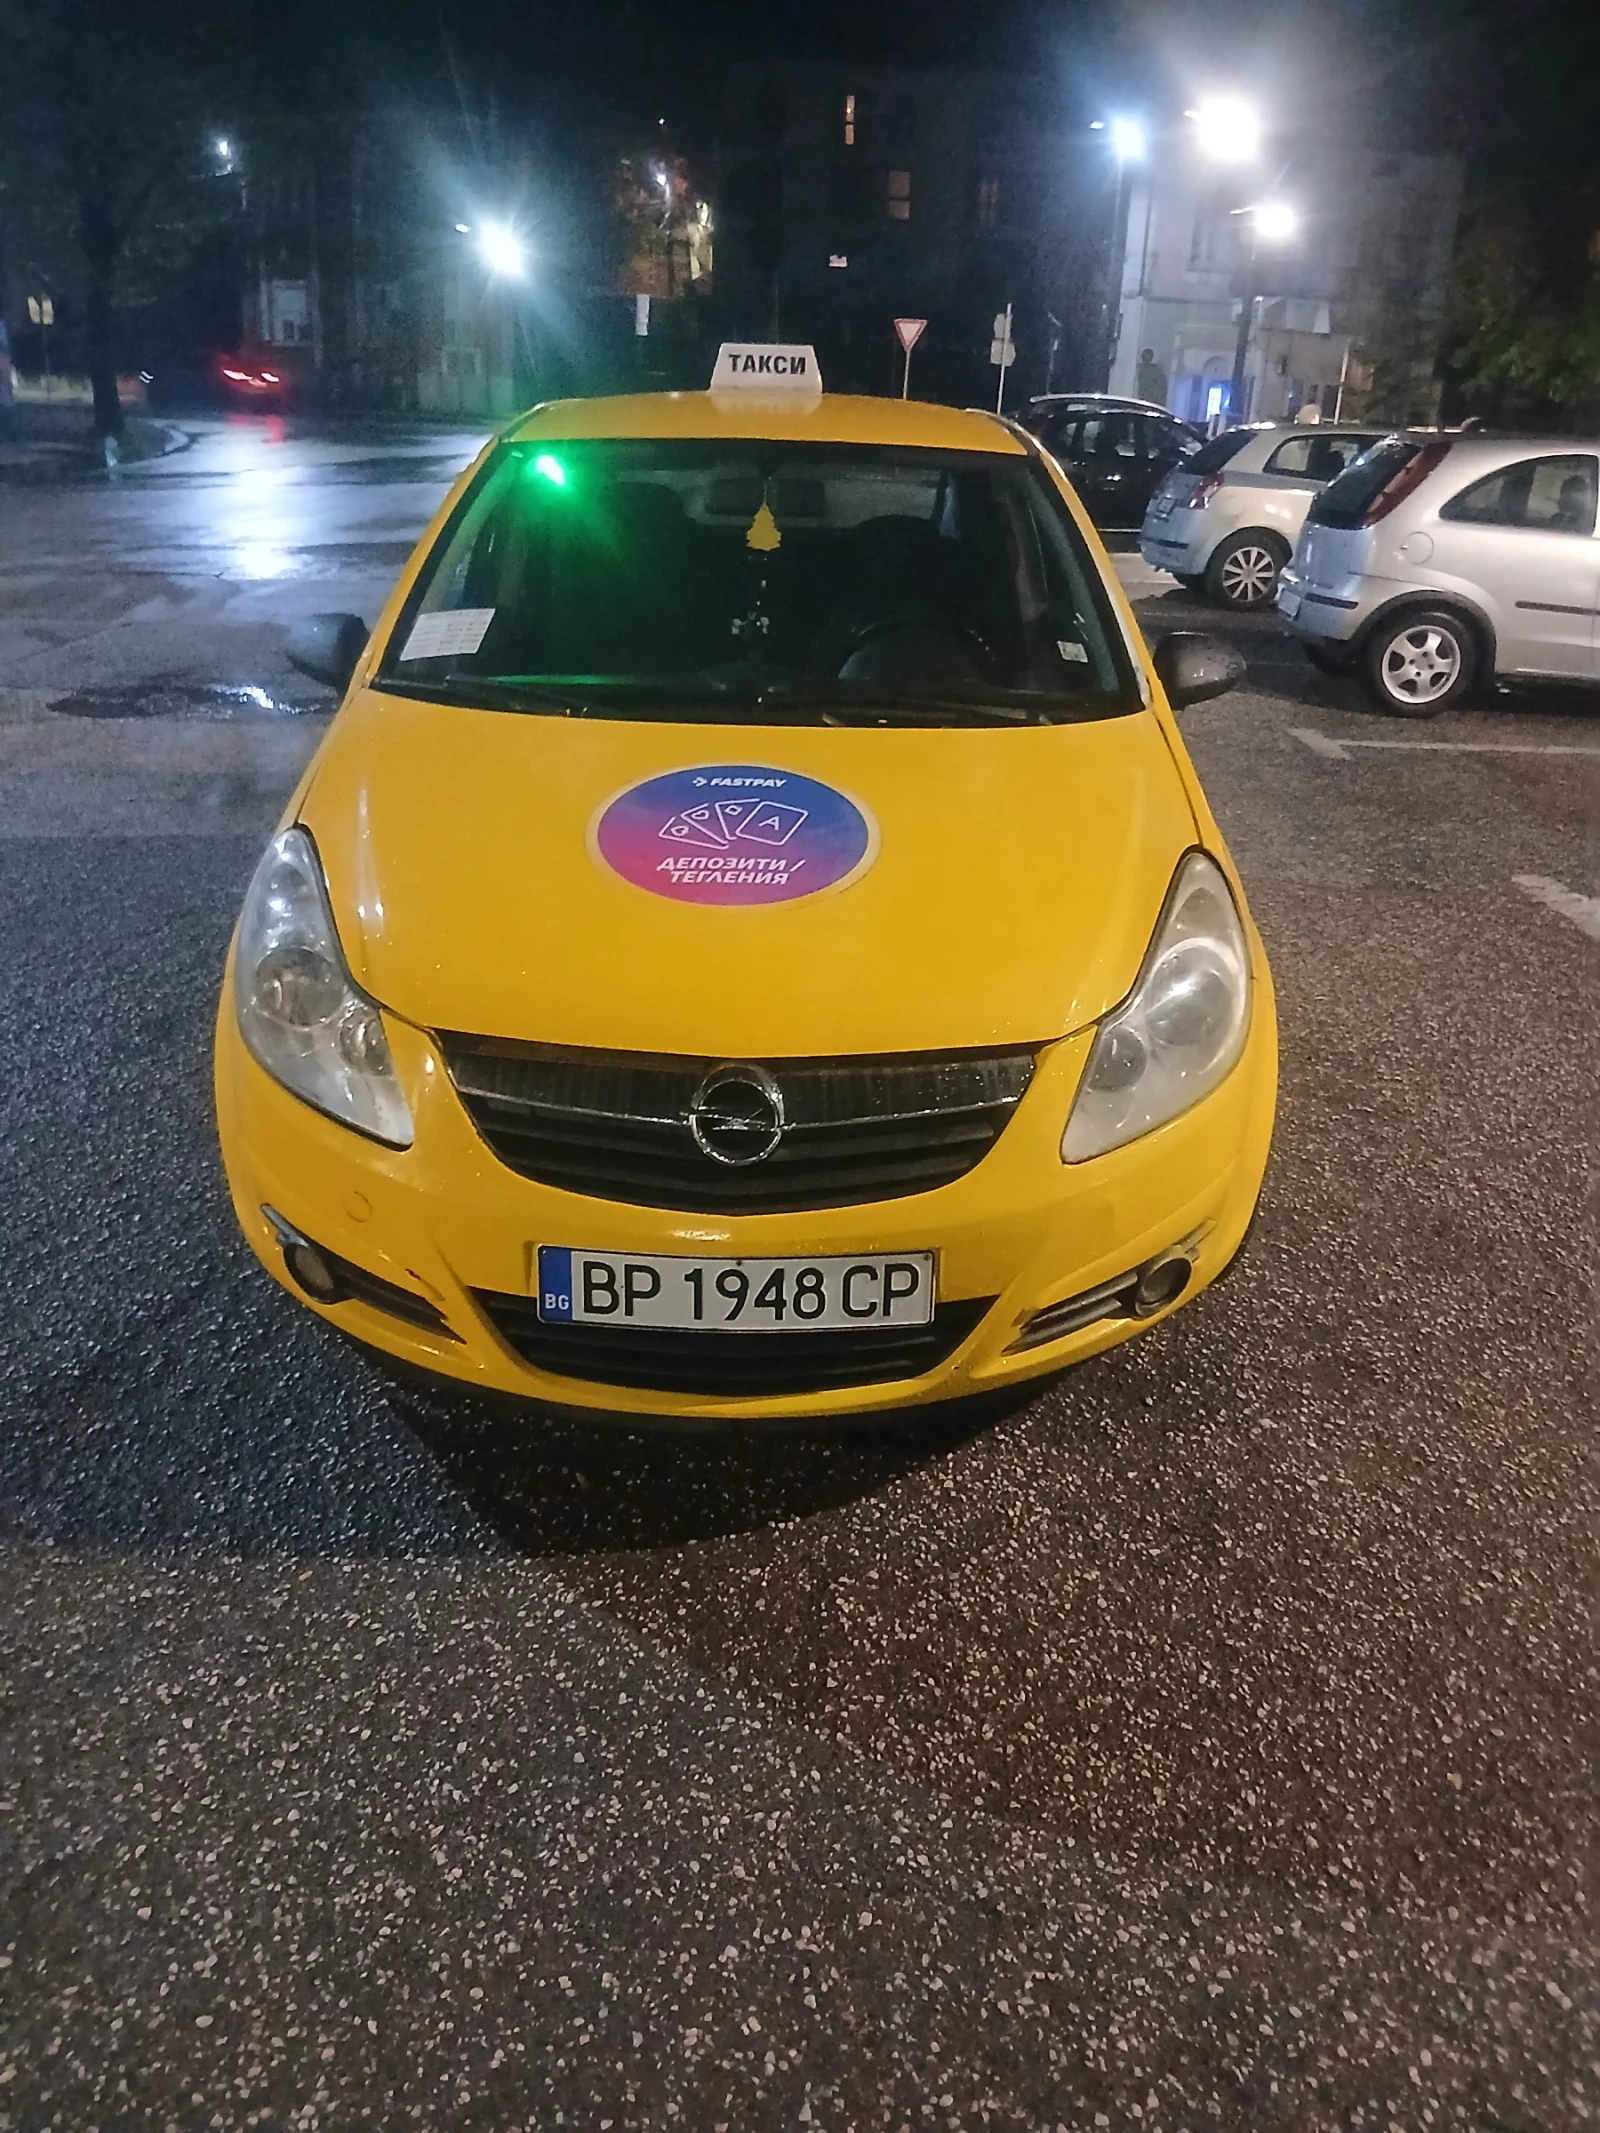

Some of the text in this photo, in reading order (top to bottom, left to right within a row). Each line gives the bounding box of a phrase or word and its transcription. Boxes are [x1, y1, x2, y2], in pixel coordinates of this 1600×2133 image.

[728, 354, 806, 375] ТАКСИ
[710, 777, 787, 788] FASTPAY
[670, 871, 789, 885] ТЕГЛЕНИЯ
[582, 1261, 919, 1321] BP 1948 CP
[545, 1293, 569, 1310] BG
